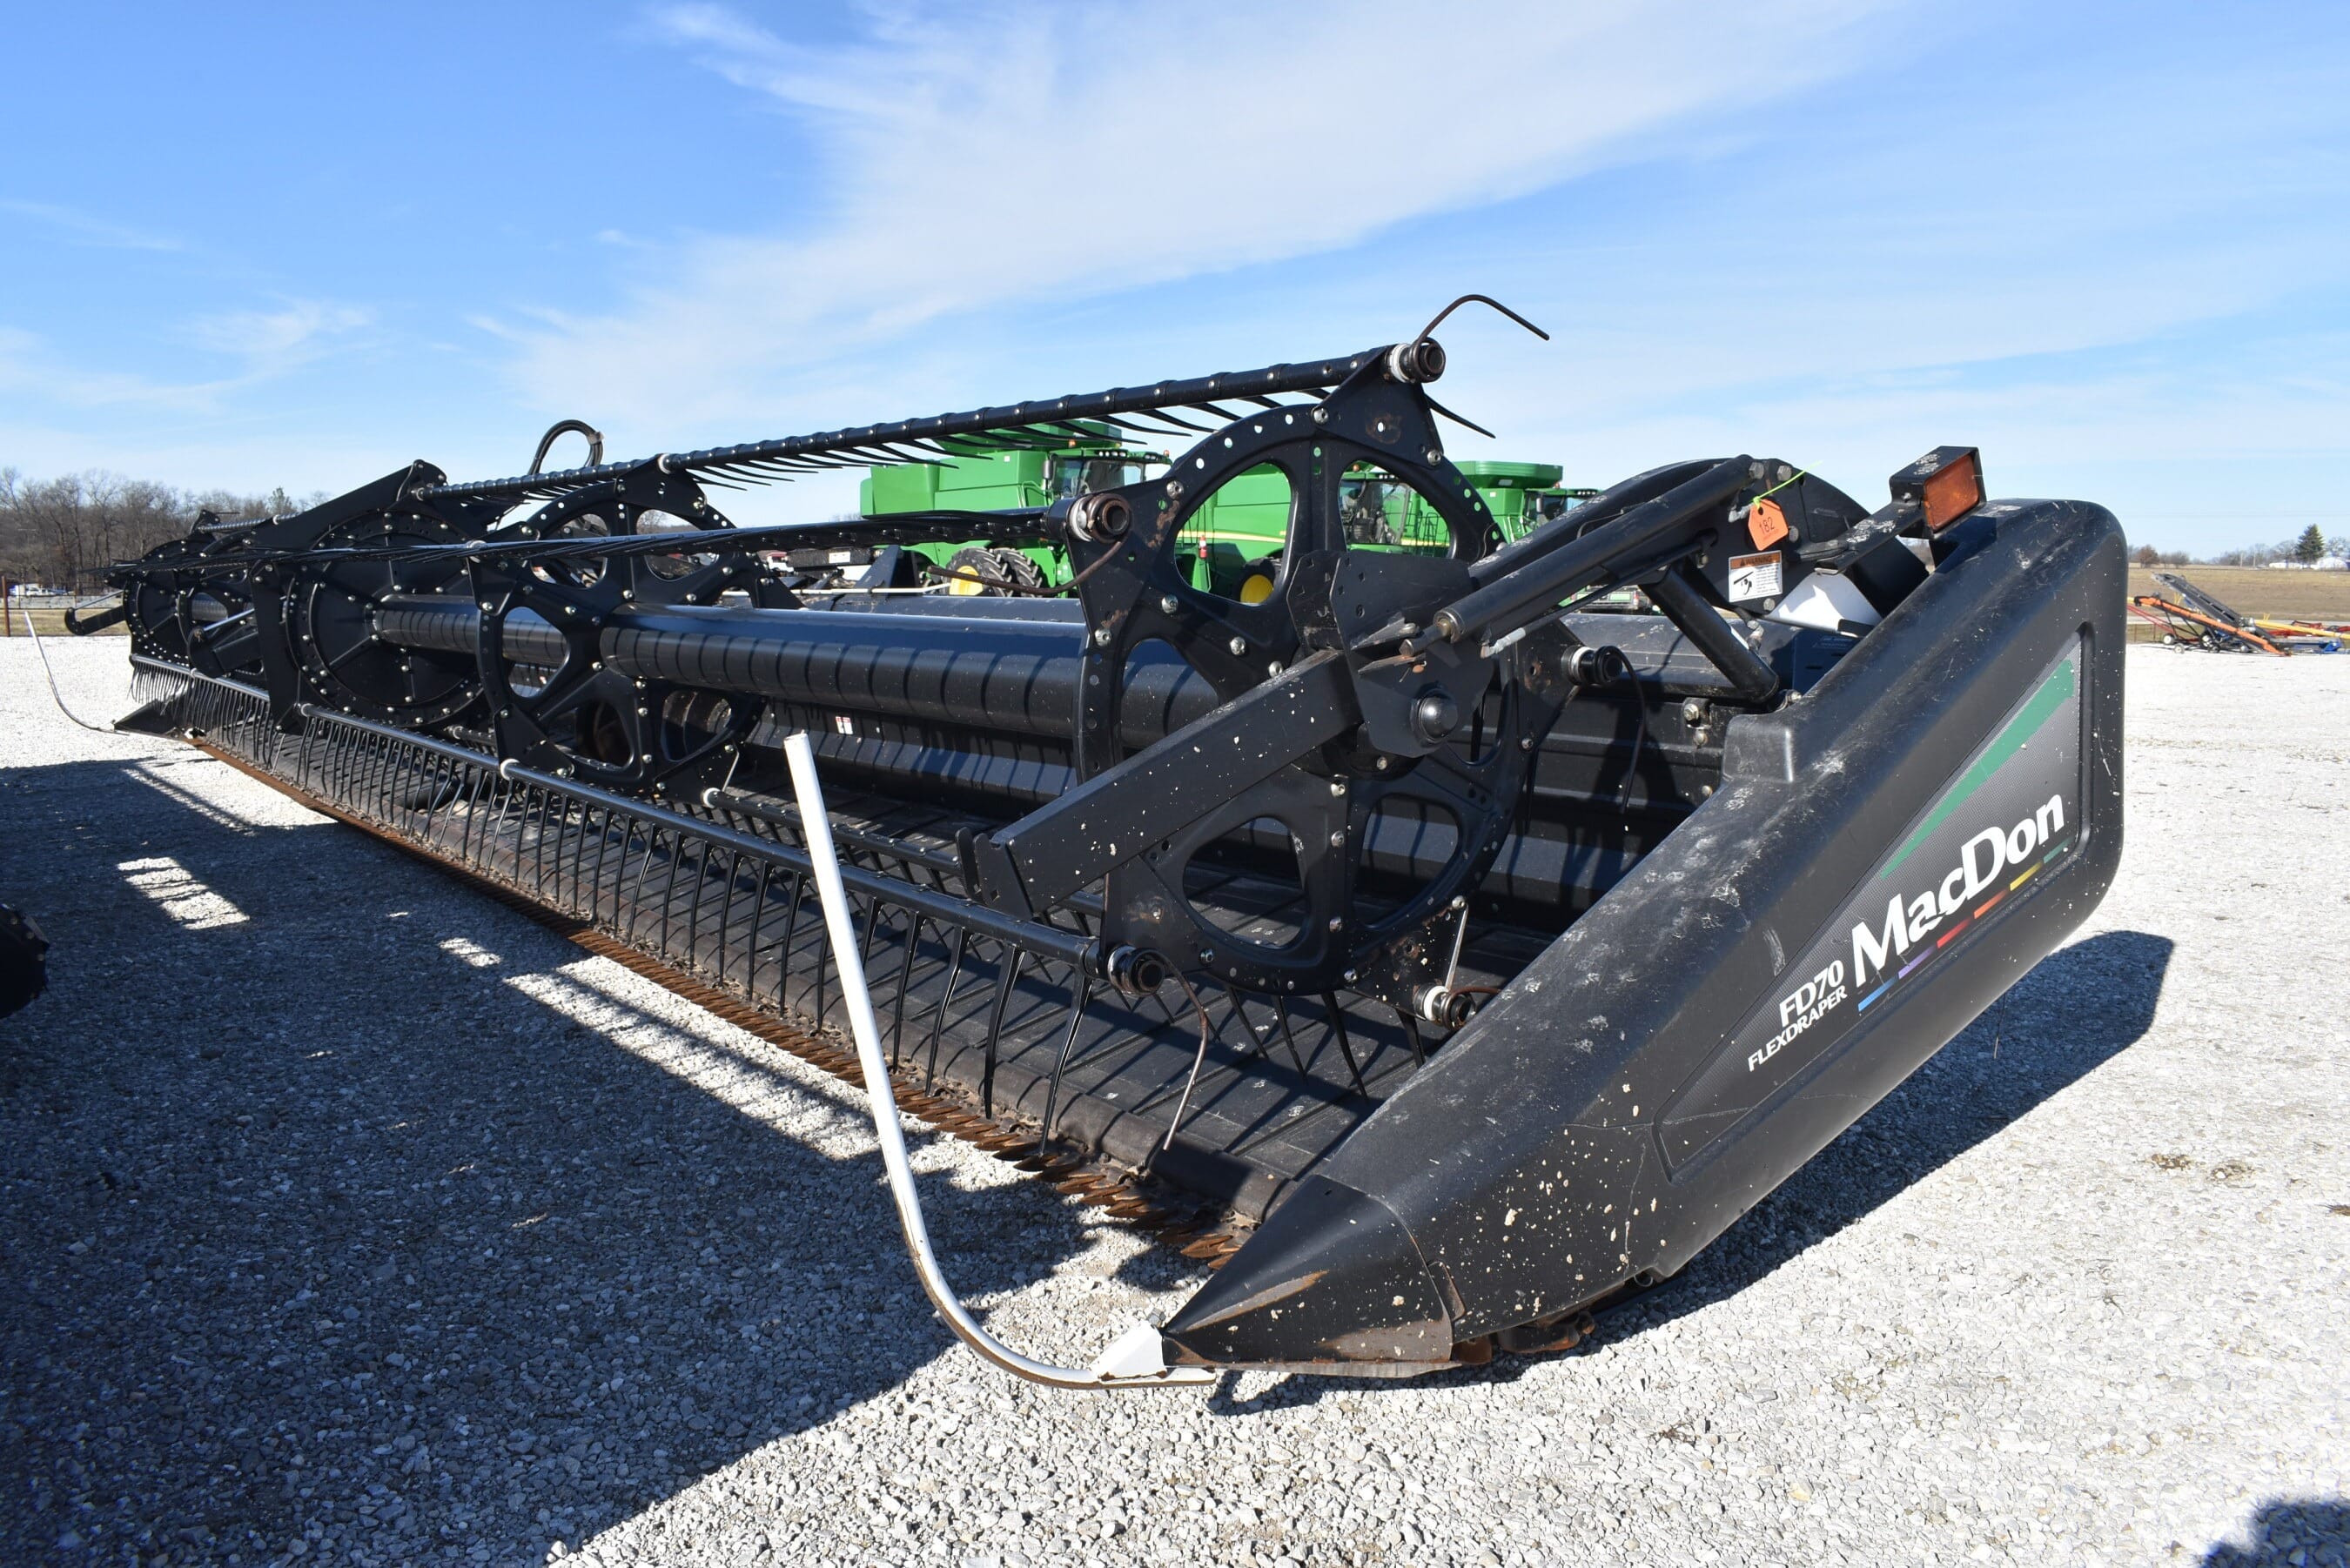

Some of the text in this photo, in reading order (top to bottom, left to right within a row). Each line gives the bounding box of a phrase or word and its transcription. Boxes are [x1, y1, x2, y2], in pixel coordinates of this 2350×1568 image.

[1759, 516, 1776, 535] 182
[1746, 554, 1772, 566] WARNING
[1851, 794, 2065, 988] MacDon
[1779, 960, 1844, 1028] FD70
[1748, 985, 1848, 1072] FLEXDRAPER
